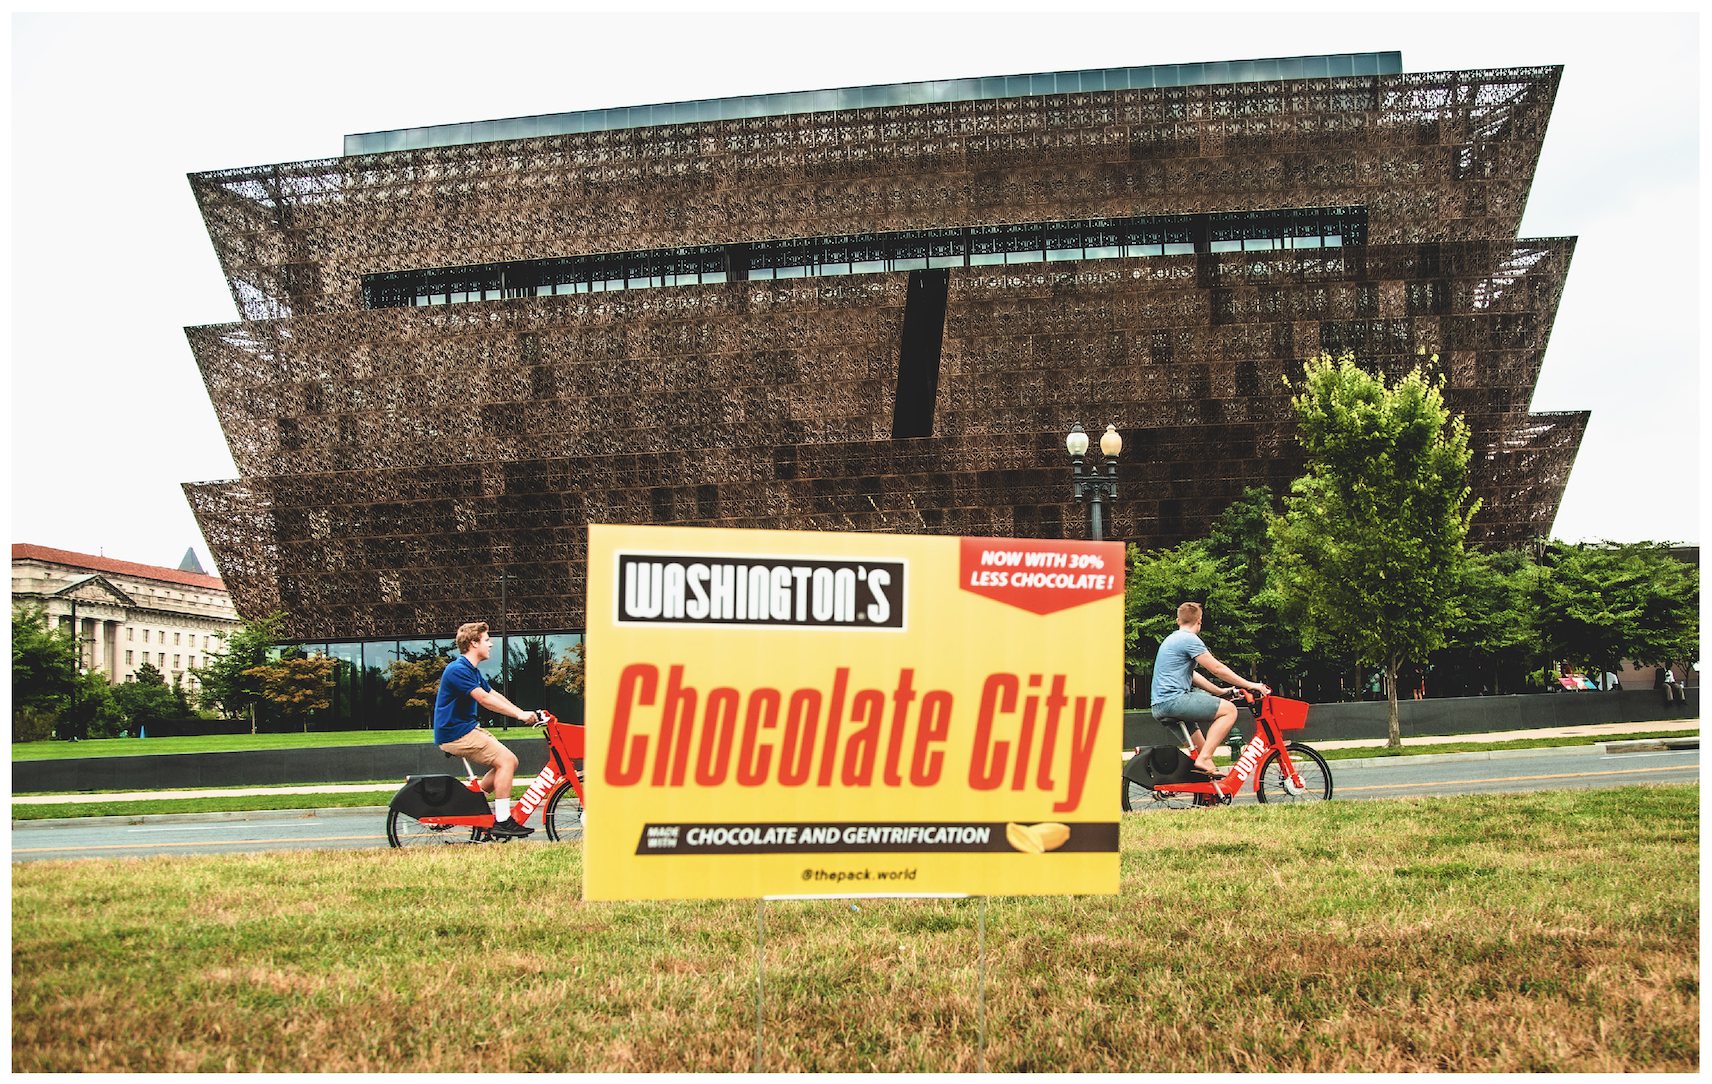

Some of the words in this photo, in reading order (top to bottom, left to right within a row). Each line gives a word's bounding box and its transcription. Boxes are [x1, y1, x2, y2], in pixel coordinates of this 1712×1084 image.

[981, 550, 1023, 567] NOW
[1024, 552, 1067, 569] WITH
[1068, 554, 1104, 569] 30%
[970, 571, 1009, 587] LESS
[625, 562, 891, 623] WASHINGTON'S
[604, 663, 954, 787] Chocolate
[968, 672, 1107, 813] City
[1234, 736, 1266, 781] JUMP
[519, 766, 556, 815] JUMP
[647, 826, 680, 837] MADE
[686, 827, 798, 846] CHOCOLATE
[798, 827, 841, 845] AND
[842, 826, 991, 845] GENTRIFICATION
[647, 837, 678, 848] WITH
[802, 868, 918, 883] @thepack.world
